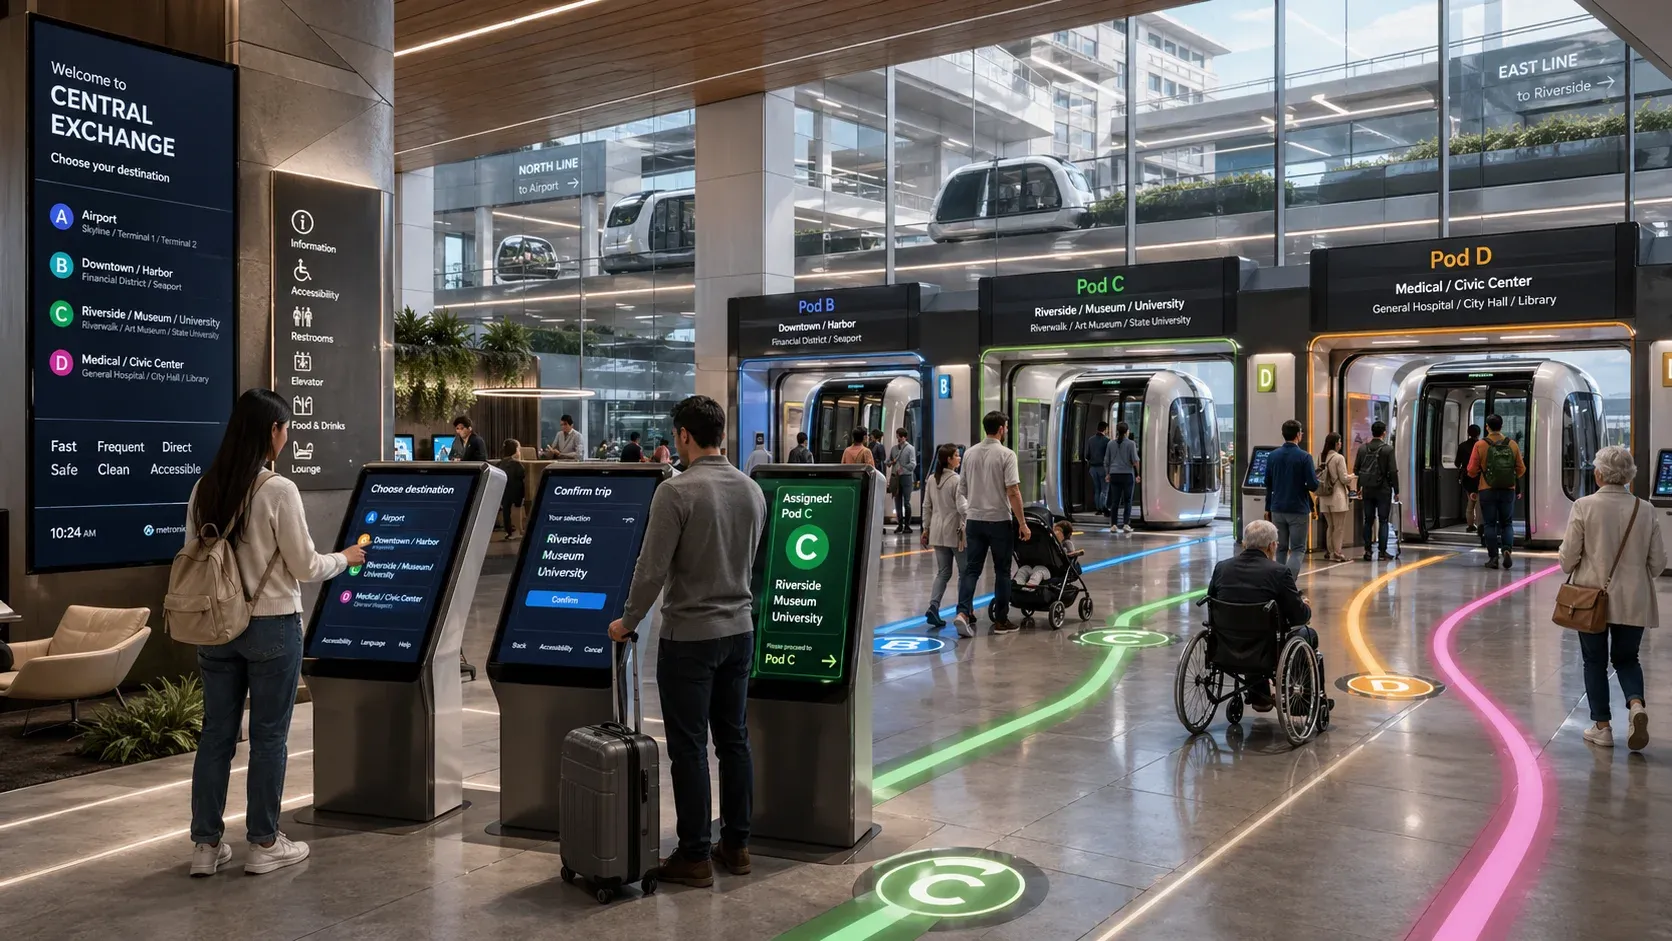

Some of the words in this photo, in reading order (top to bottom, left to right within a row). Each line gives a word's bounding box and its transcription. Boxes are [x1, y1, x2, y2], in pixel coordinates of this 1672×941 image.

[1499, 60, 1538, 79] EAST
[1542, 53, 1578, 71] LINE
[51, 61, 110, 86] Welcome
[114, 77, 126, 90] to
[1517, 91, 1530, 102] to
[1535, 80, 1591, 98] Riverside
[50, 85, 153, 125] CENTRAL
[51, 114, 175, 157] EXCHANGE
[51, 152, 90, 168] Choose
[92, 161, 115, 173] your
[118, 164, 170, 182] destination
[519, 161, 553, 175] NORTH
[556, 158, 578, 170] LINE
[519, 186, 527, 194] to
[530, 181, 559, 193] Airport
[56, 210, 68, 224] A
[82, 210, 117, 224] Airport
[82, 224, 110, 237] Skyline
[117, 229, 150, 242] Terminal
[161, 236, 189, 247] Terminal
[291, 238, 336, 253] Information
[1431, 248, 1469, 268] Pod
[1477, 246, 1492, 265] D
[56, 258, 68, 272] B
[82, 258, 134, 274] Downtown
[142, 266, 173, 278] Harbor
[82, 273, 117, 284] Financial
[119, 277, 146, 287] District
[153, 280, 182, 291] Seaport
[1077, 276, 1107, 295] Pod
[1112, 275, 1124, 292] C
[1396, 279, 1443, 295] Medical
[1446, 279, 1451, 292] /
[1454, 278, 1485, 291] Civic
[1488, 276, 1532, 288] Center
[291, 286, 340, 301] Accessibility
[799, 299, 822, 314] Pod
[826, 298, 835, 311] B
[1035, 305, 1077, 317] Riverside
[1085, 302, 1125, 314] Museum
[1134, 299, 1185, 312] University
[1373, 302, 1410, 314] General
[1413, 299, 1453, 313] Hospital
[1464, 298, 1484, 311] City
[1487, 296, 1508, 307] Hall
[1518, 295, 1557, 308] Library
[55, 306, 67, 322] C
[82, 306, 125, 320] Riverside
[134, 311, 171, 323] Museum
[180, 315, 220, 329] University
[82, 321, 118, 332] Riverwalk
[124, 324, 136, 333] Art
[137, 326, 166, 336] Museum
[172, 328, 188, 337] State
[190, 330, 219, 340] University
[778, 322, 820, 333] Downtown
[828, 320, 856, 329] Harbor
[1030, 322, 1067, 333] Riverwalk
[1075, 320, 1086, 330] Art
[1089, 319, 1122, 329] Museum
[1129, 317, 1150, 327] State
[1152, 315, 1192, 327] University
[291, 331, 333, 343] Restrooms
[772, 336, 801, 346] Financial
[802, 336, 827, 344] District
[833, 334, 862, 344] Seaport
[56, 355, 68, 370] D
[82, 354, 120, 366] Medical
[129, 357, 152, 367] Civic
[154, 359, 184, 369] Center
[82, 369, 112, 379] General
[114, 371, 145, 381] Hospital
[151, 373, 164, 383] City
[166, 373, 180, 382] Hall
[186, 374, 209, 384] Library
[292, 377, 323, 386] Elevator
[1261, 369, 1272, 387] D
[940, 379, 947, 394] B
[292, 421, 311, 430] Food
[321, 422, 345, 430] Drinks
[51, 440, 77, 452] Fast
[98, 441, 144, 454] Frequent
[163, 442, 192, 452] Direct
[51, 464, 78, 475] Safe
[98, 464, 129, 475] Clean
[150, 464, 201, 475] Accessible
[292, 465, 321, 475] Lounge
[371, 484, 403, 493] Choose
[405, 485, 455, 494] destination
[554, 486, 592, 496] Confirm
[595, 487, 612, 498] trip
[782, 493, 832, 505] Assigned:
[381, 514, 405, 522] Airport
[782, 508, 802, 519] Pod
[804, 509, 812, 519] C
[50, 527, 81, 538] 10:24
[547, 534, 592, 544] Riverside
[374, 536, 410, 544] Downtown
[795, 533, 818, 560] C
[542, 550, 584, 560] Museum
[538, 567, 588, 580] University
[775, 579, 821, 590] Riverside
[552, 596, 578, 604] Confirm
[773, 595, 816, 606] Museum
[772, 612, 823, 626] University
[360, 639, 386, 647] Language
[399, 641, 412, 649] Help
[1103, 634, 1144, 644] C
[765, 654, 784, 664] Pod
[787, 655, 795, 665] C
[1371, 680, 1409, 692] D
[908, 874, 985, 906] C
